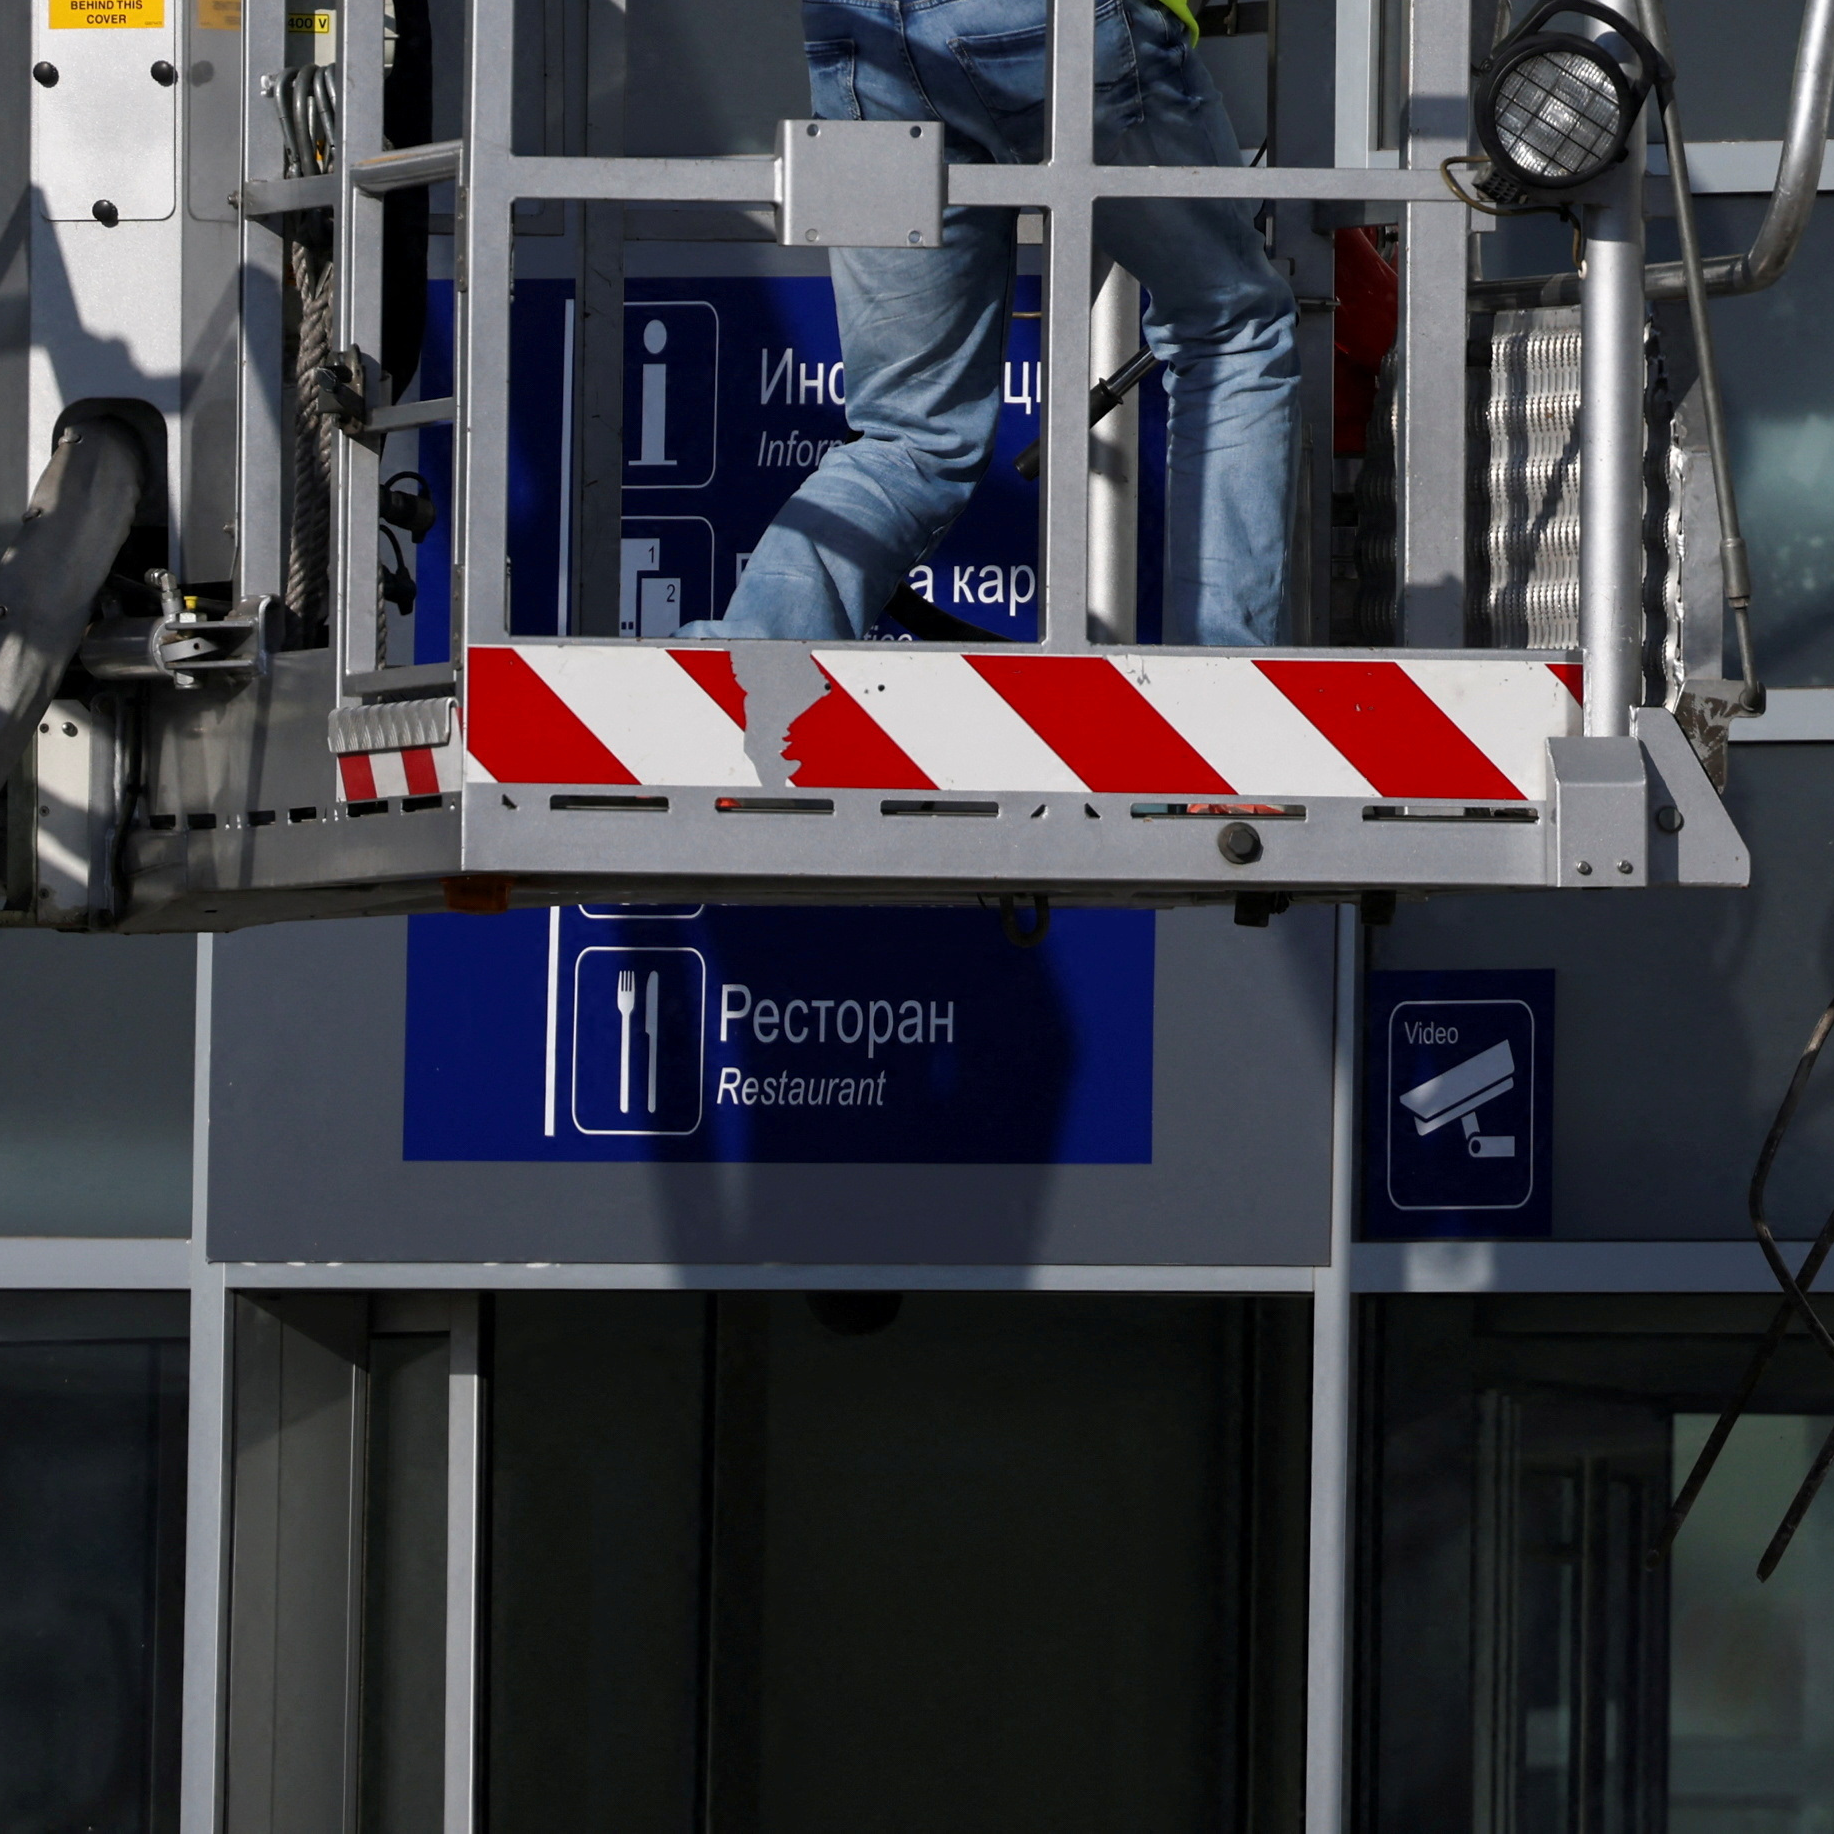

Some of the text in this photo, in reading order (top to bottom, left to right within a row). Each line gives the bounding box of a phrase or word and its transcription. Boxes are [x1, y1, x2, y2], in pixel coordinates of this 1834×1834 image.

[70, 0, 143, 10] BEHIND THIS
[86, 14, 127, 24] COVER
[287, 18, 327, 29] 400 V
[666, 584, 676, 603] 2
[953, 564, 1037, 616] кар
[720, 983, 955, 1059] Ресторан
[1404, 1021, 1459, 1045] Video
[717, 1066, 887, 1106] Restaurant
